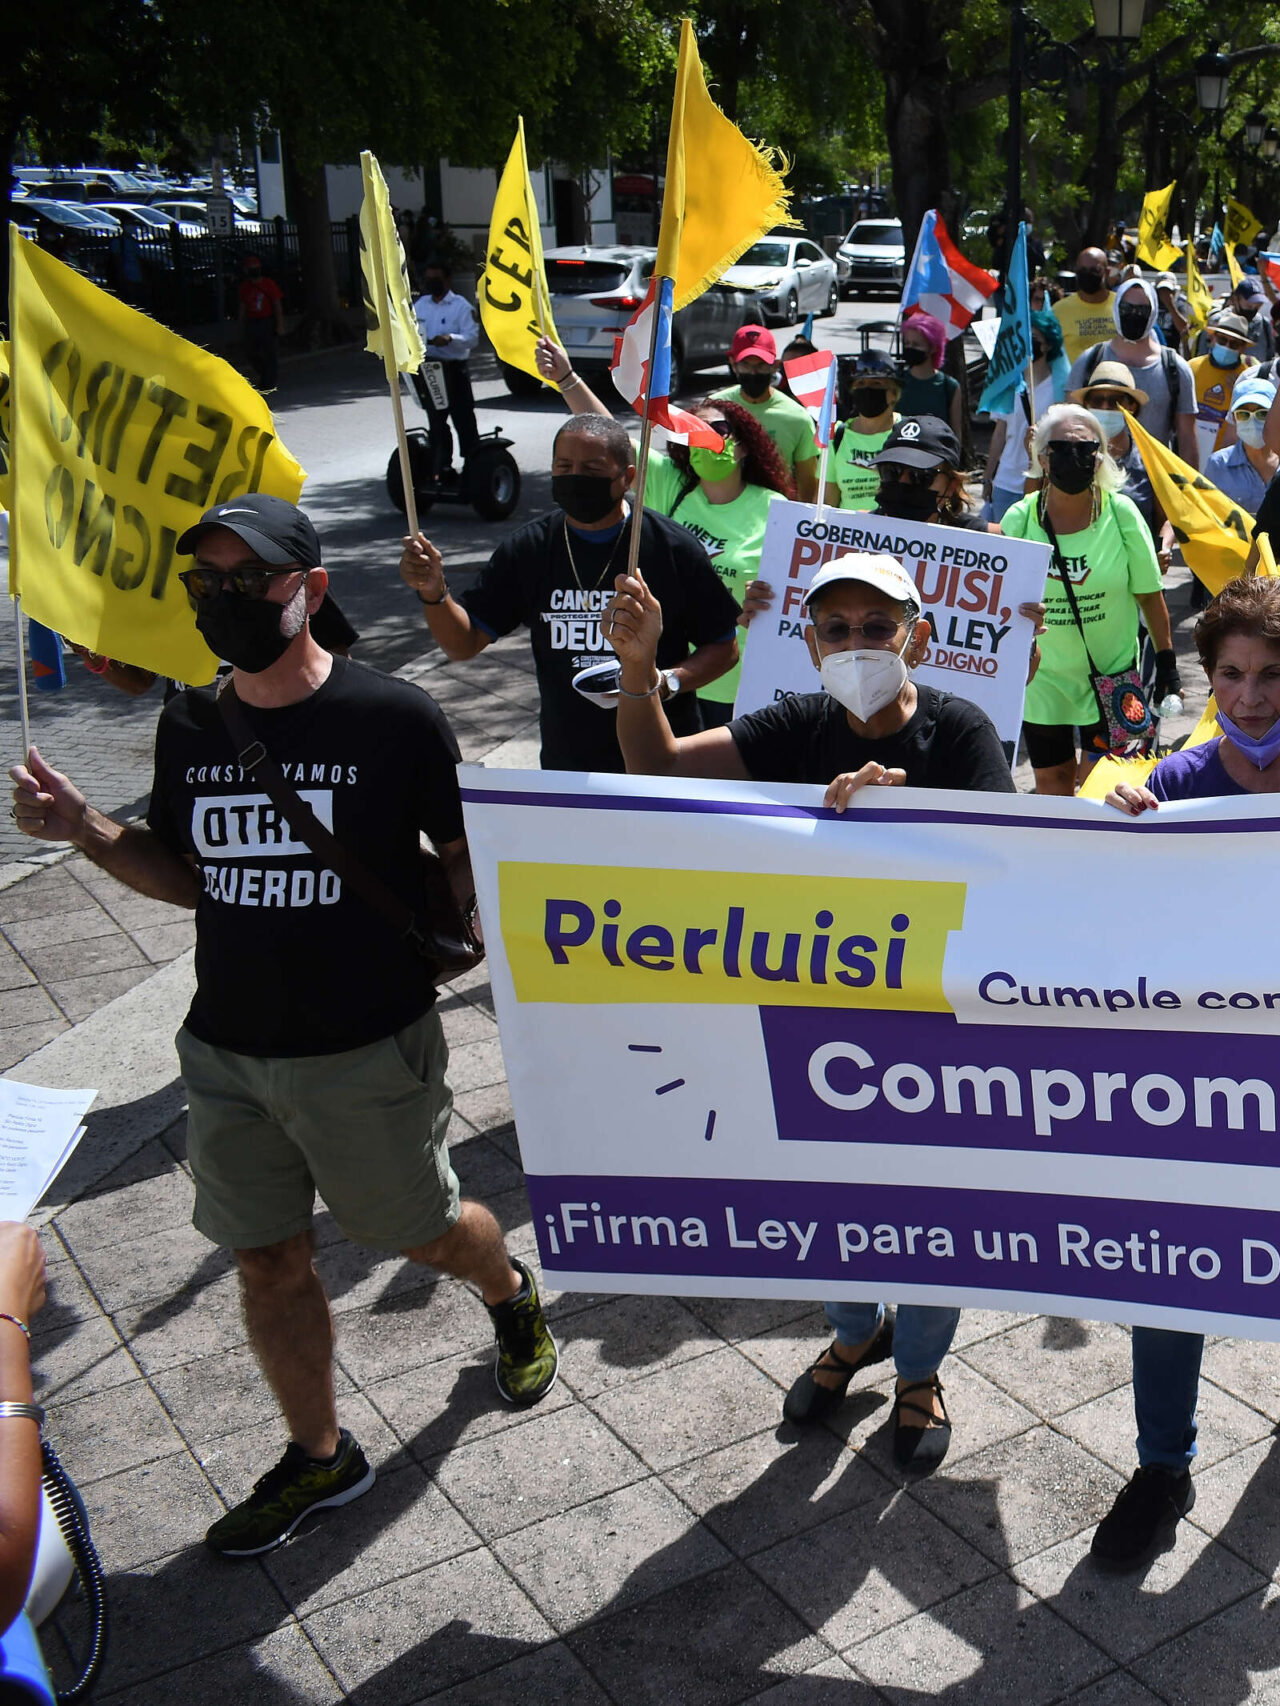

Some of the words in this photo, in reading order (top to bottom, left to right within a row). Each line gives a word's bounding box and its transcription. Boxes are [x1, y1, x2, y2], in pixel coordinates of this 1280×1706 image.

[211, 216, 227, 227] 15
[423, 363, 446, 407] SECURITY
[796, 519, 937, 561] GOBERNADOR
[940, 545, 1008, 573] PEDRO
[550, 589, 618, 611] CANCE
[788, 537, 1012, 625] PIUISI,
[947, 615, 1012, 655] LEY
[935, 650, 998, 676] DIGNO
[185, 762, 358, 785] CONSTYAMOS
[203, 801, 313, 847] OTR
[196, 864, 342, 908] CUERDO
[545, 898, 910, 990] Pierluisi
[978, 970, 1182, 1012] Cumple
[545, 1201, 708, 1255] ¡Firma
[725, 1206, 818, 1262] Ley
[836, 1220, 955, 1263] para
[974, 1230, 1038, 1263] un
[1057, 1222, 1221, 1280] Retiro
